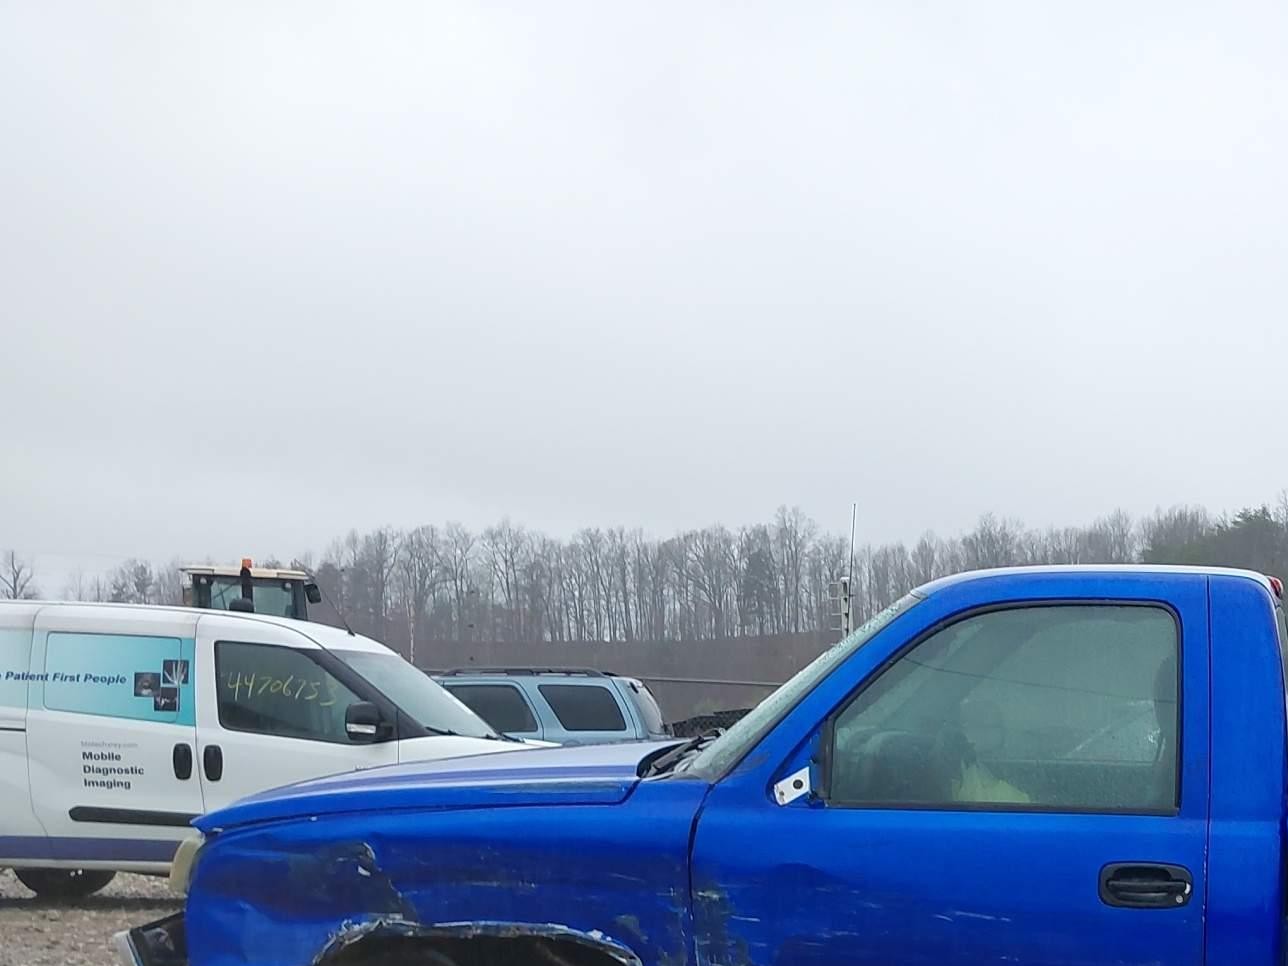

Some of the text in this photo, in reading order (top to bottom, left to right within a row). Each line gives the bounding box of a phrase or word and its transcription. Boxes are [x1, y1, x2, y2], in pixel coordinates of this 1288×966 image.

[5, 671, 48, 681] Patient
[52, 672, 80, 683] First
[84, 673, 127, 686] People
[82, 752, 121, 761] Mobile
[83, 765, 144, 776] Diagnostic
[84, 779, 131, 790] Imaging
